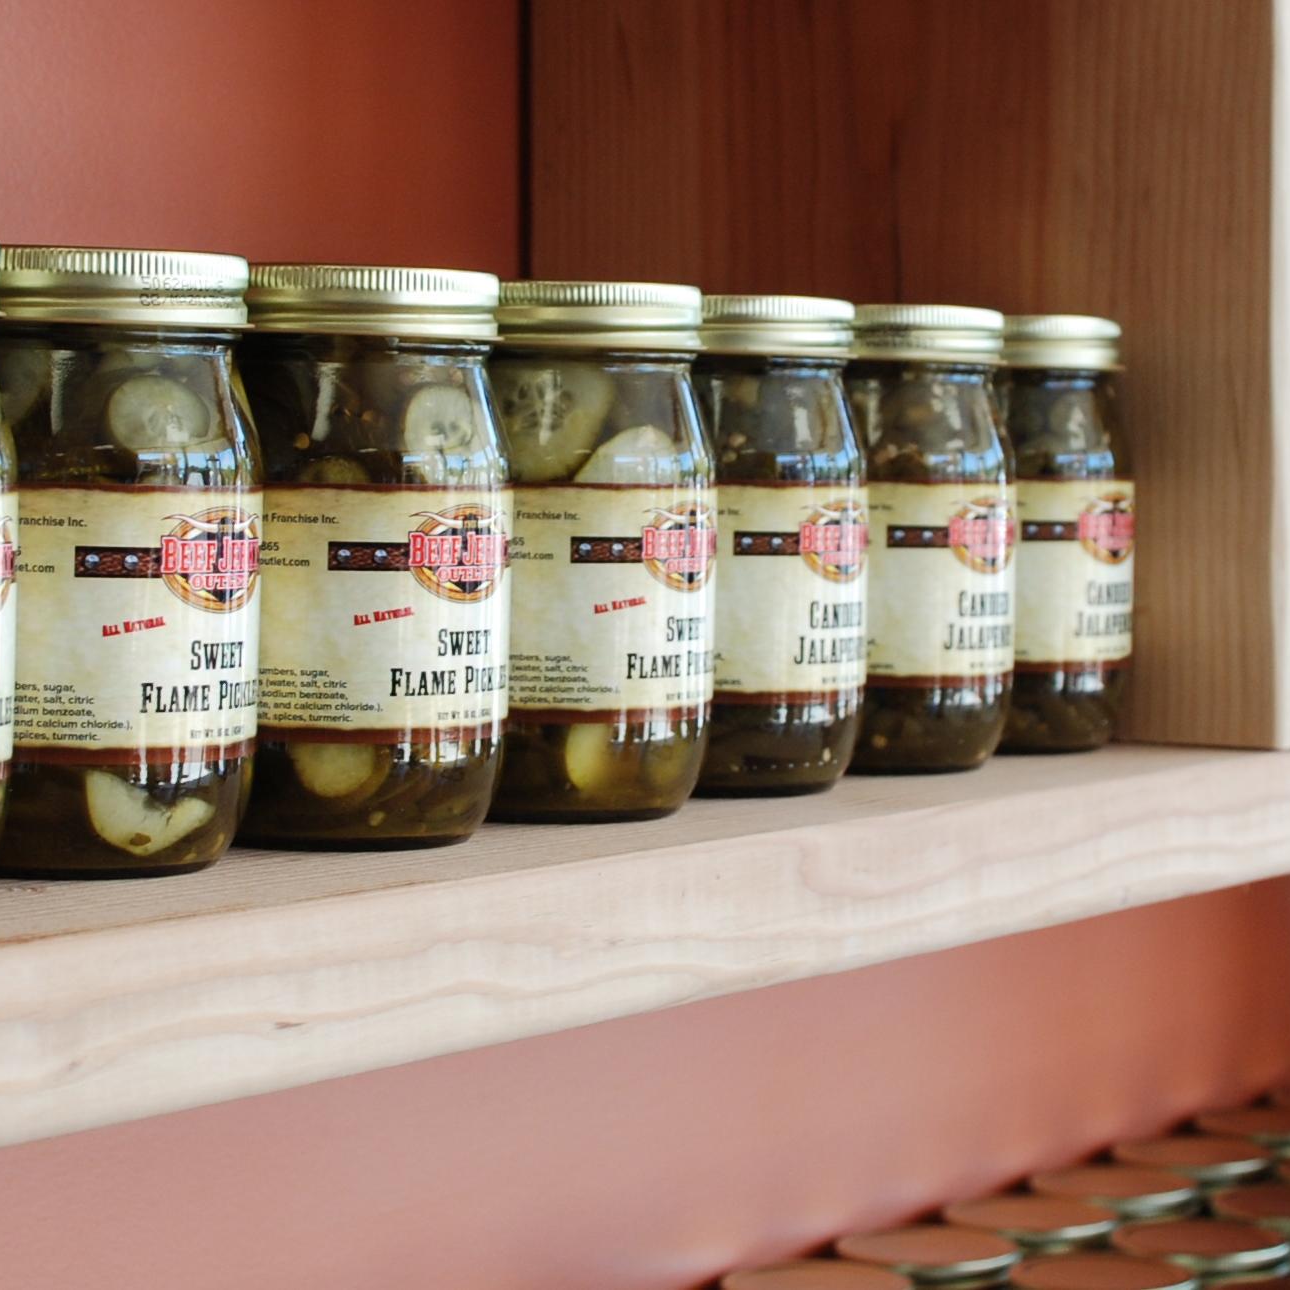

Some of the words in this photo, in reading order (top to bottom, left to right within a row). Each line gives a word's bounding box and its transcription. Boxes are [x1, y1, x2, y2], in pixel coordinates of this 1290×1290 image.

[271, 512, 319, 524] Franchise
[321, 514, 340, 524] Inc.
[516, 510, 562, 520] Franchise
[564, 511, 582, 520] Inc.
[19, 516, 65, 527] ranchise
[67, 516, 88, 527] Inc.
[410, 533, 462, 566] BEEF
[164, 538, 217, 573] BEEF
[354, 614, 371, 626] ALL
[101, 625, 121, 637] ALL
[123, 616, 166, 633] NATURAL
[666, 616, 706, 642] SWEE
[437, 628, 491, 657] SWEET
[190, 640, 244, 670] SWEET
[626, 653, 681, 679] FLAME
[300, 669, 330, 678] sugar,
[300, 680, 321, 689] salt,
[323, 680, 347, 689] citric
[389, 668, 457, 697] FLAME
[43, 683, 76, 694] sugar,
[43, 696, 66, 705] salt,
[67, 696, 96, 705] citric
[139, 682, 211, 713] FLAME
[299, 690, 349, 700] benzoate,
[294, 701, 332, 711] calcium
[42, 707, 96, 718] benzoate,
[309, 713, 354, 722] turmeric.
[36, 719, 78, 729] calcium
[52, 731, 102, 741] turmeric.
